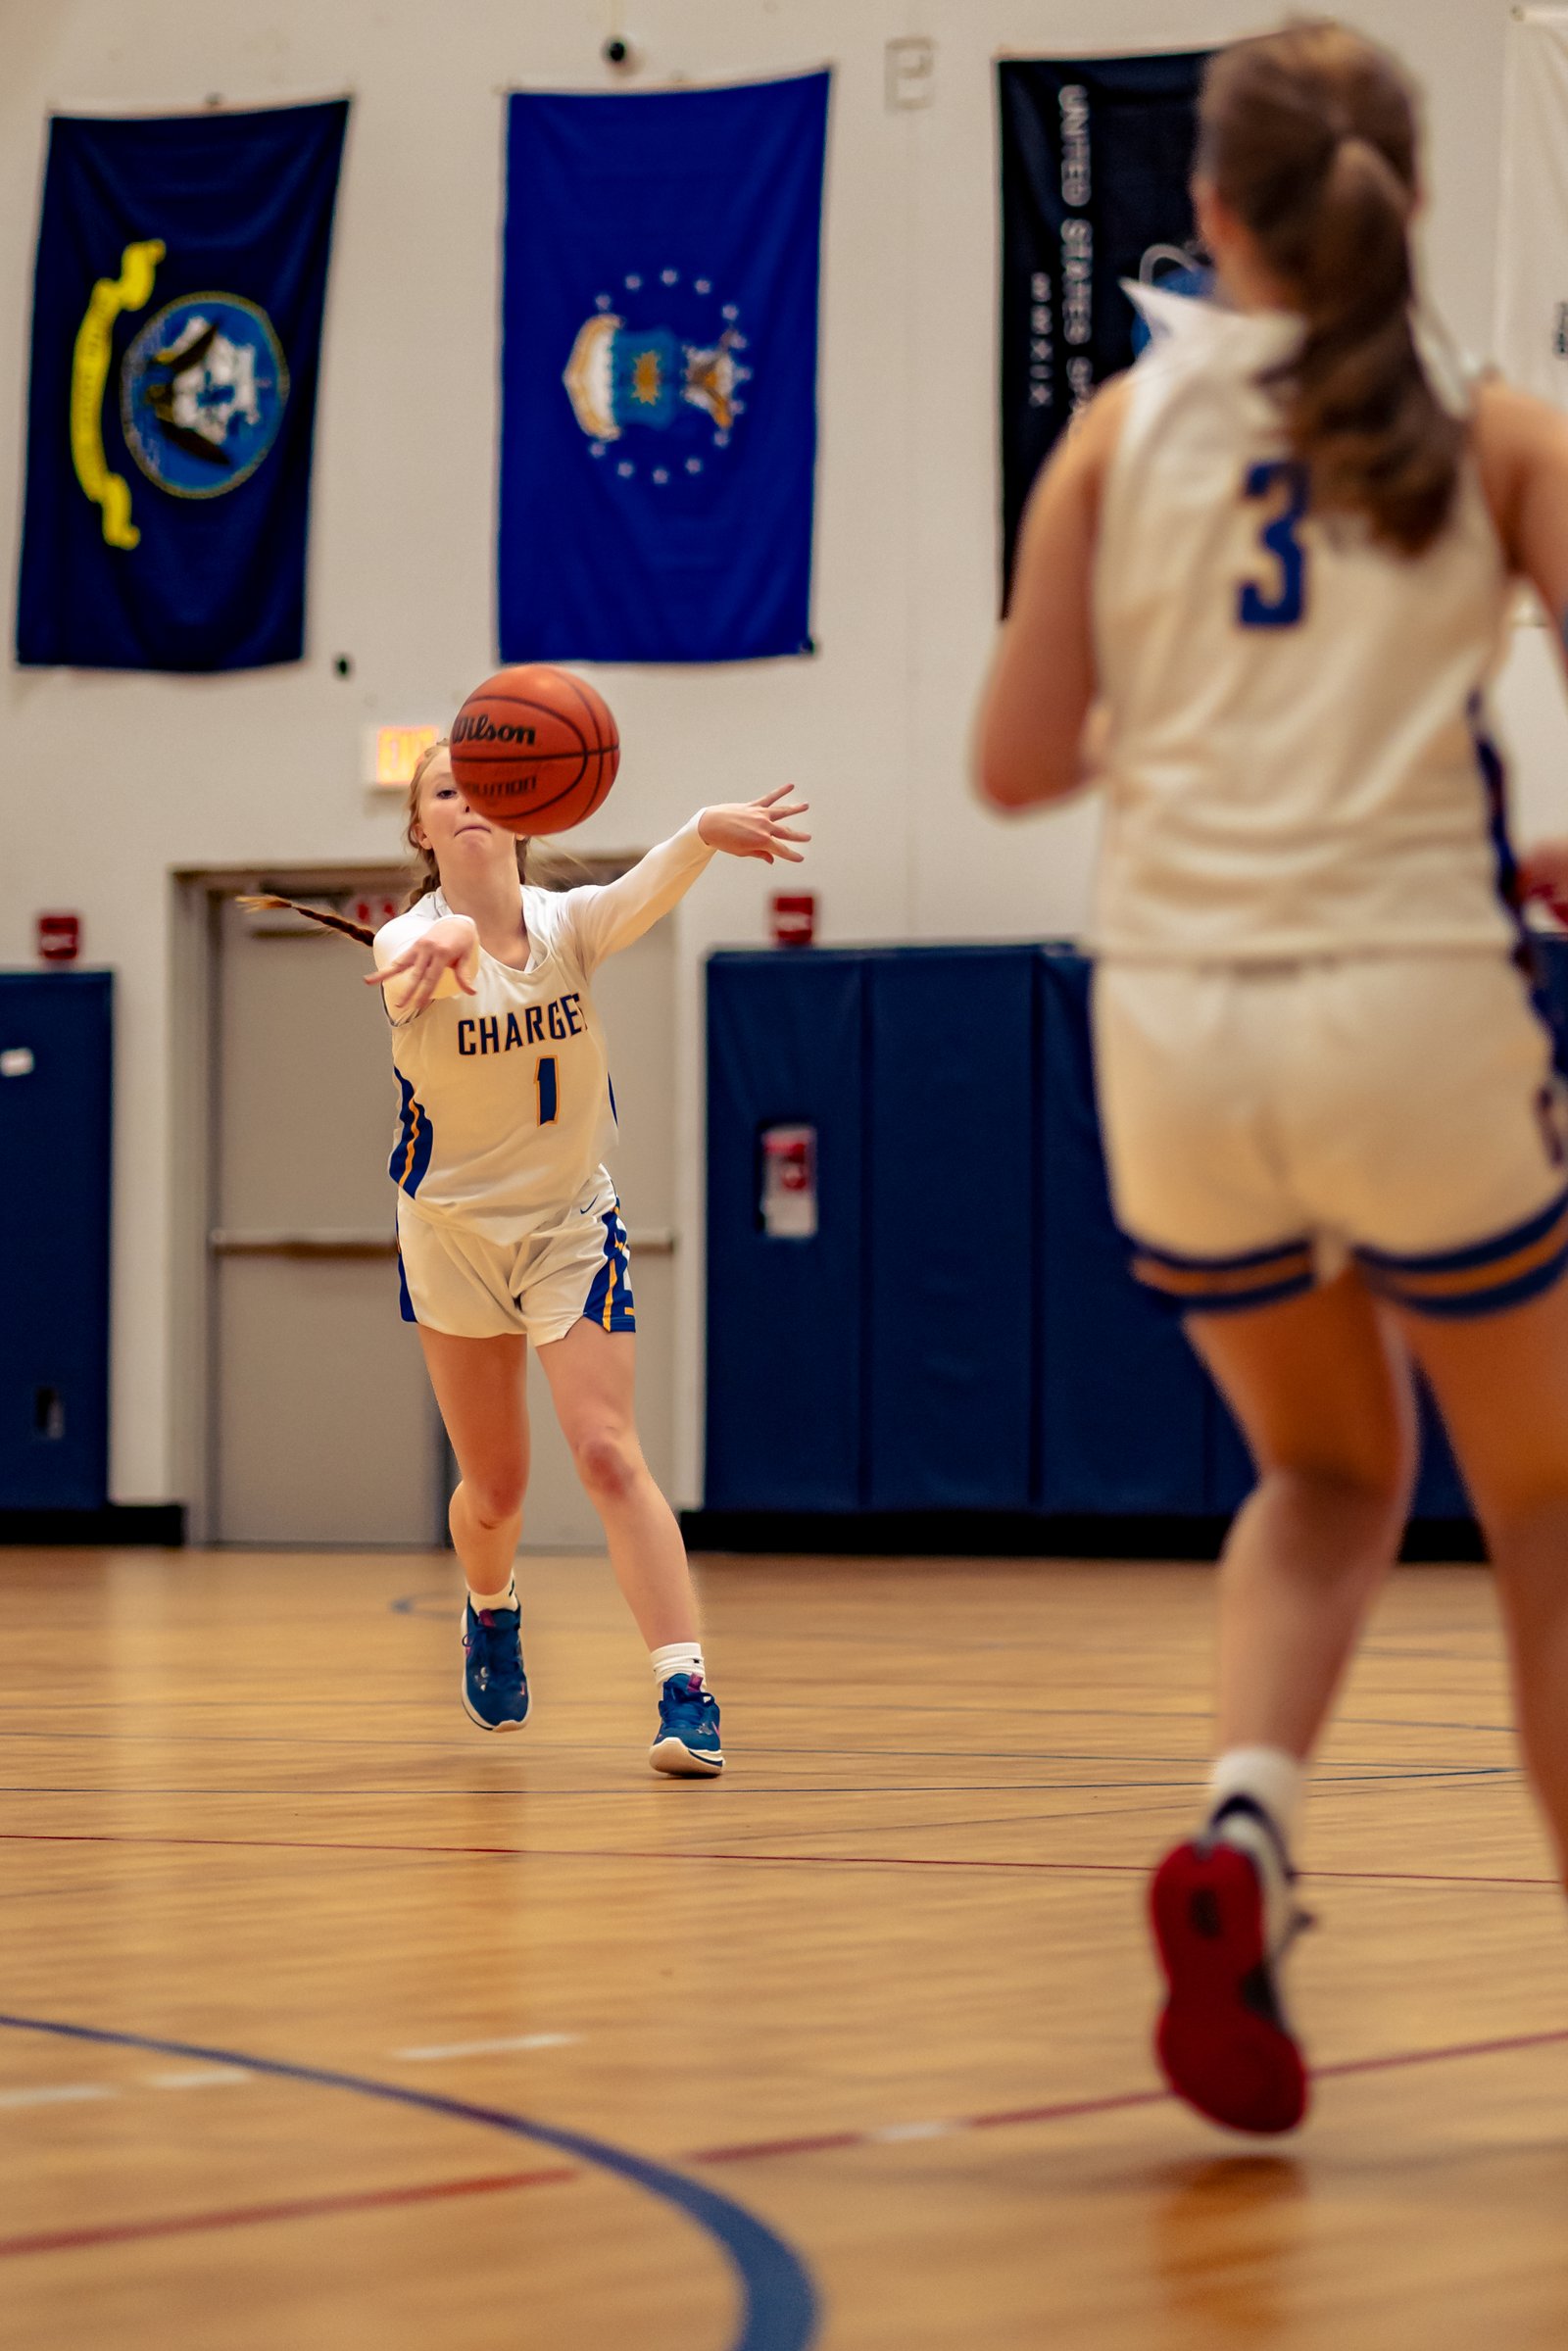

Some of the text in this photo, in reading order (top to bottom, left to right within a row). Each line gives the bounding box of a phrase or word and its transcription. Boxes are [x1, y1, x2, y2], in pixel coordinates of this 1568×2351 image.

[1059, 84, 1091, 206] UNITED
[1061, 218, 1093, 345] STATES
[1239, 461, 1308, 627] 3
[452, 713, 536, 746] Wilson
[534, 1054, 559, 1127] 1
